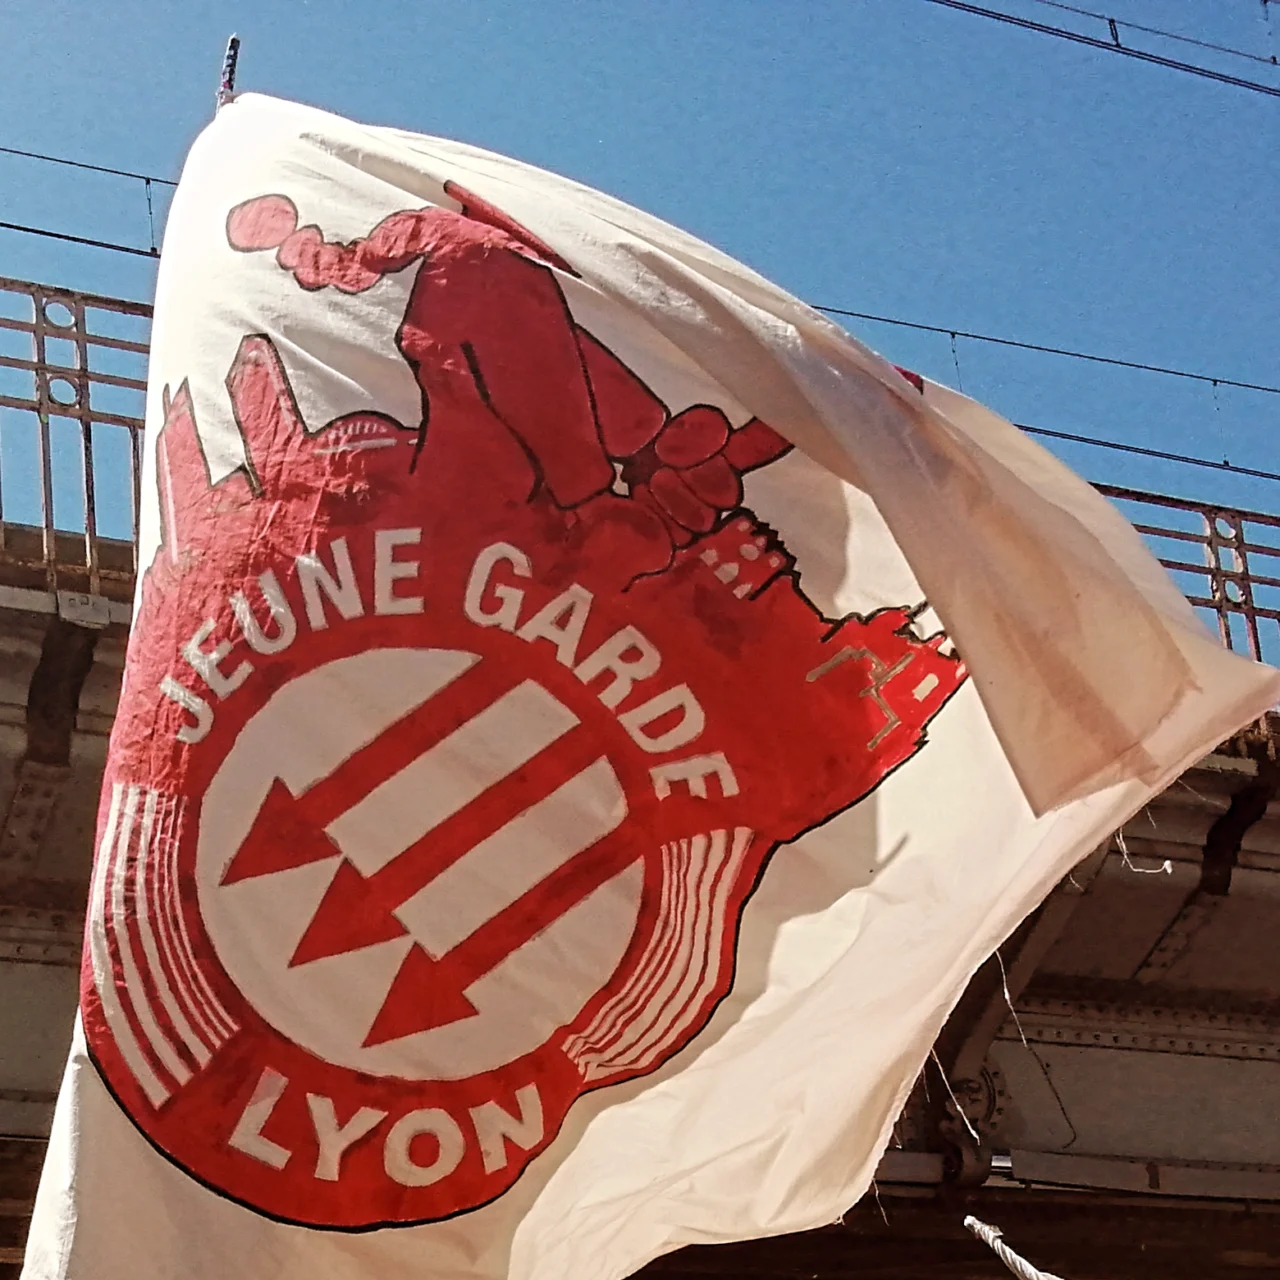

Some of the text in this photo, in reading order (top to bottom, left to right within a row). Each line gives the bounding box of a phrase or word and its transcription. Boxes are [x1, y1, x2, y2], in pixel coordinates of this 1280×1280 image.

[158, 526, 741, 802] JEUNE GARDE
[227, 1065, 545, 1188] LYON
